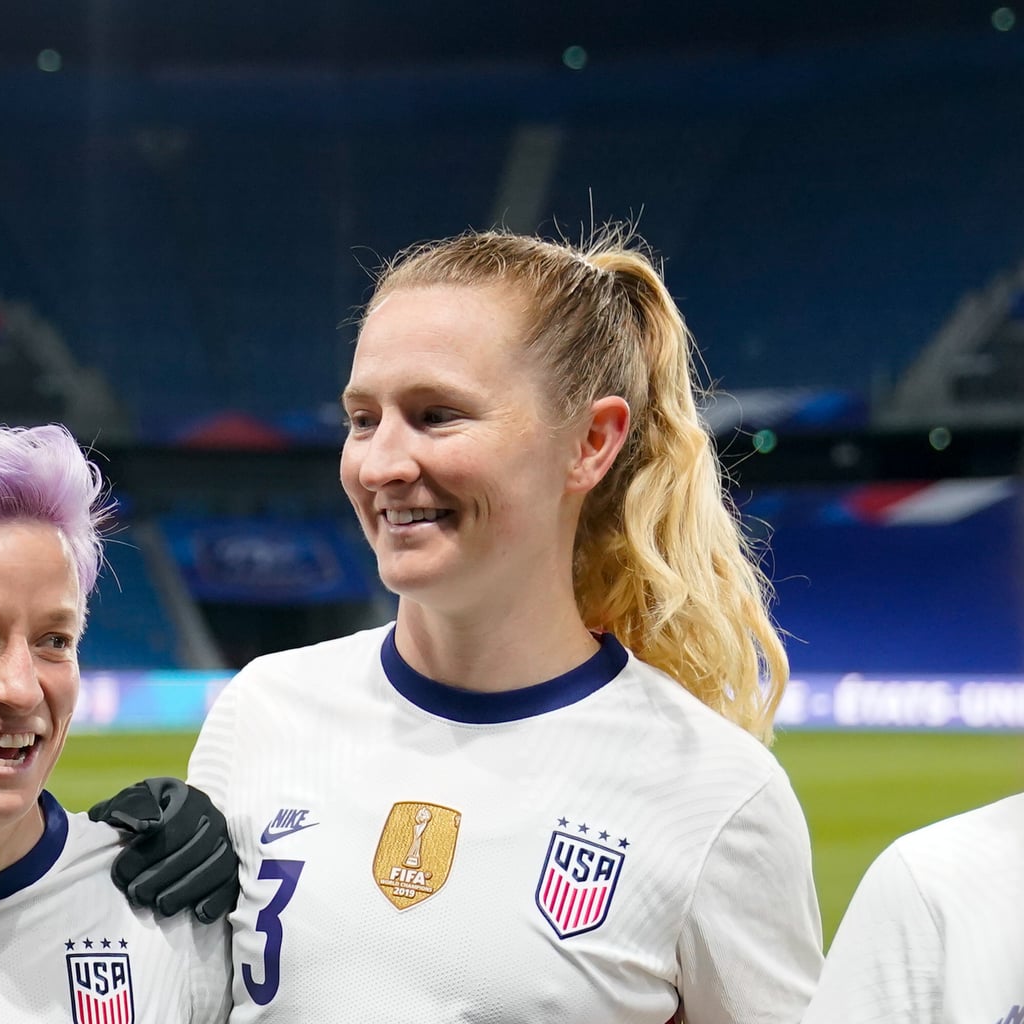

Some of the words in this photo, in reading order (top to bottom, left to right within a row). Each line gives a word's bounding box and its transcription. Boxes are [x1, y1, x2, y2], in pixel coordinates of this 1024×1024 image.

[270, 808, 310, 829] NIKE
[390, 867, 426, 885] FIFA
[554, 841, 616, 883] USA
[393, 887, 416, 898] 2019
[241, 859, 306, 1006] 3
[74, 961, 126, 996] USA
